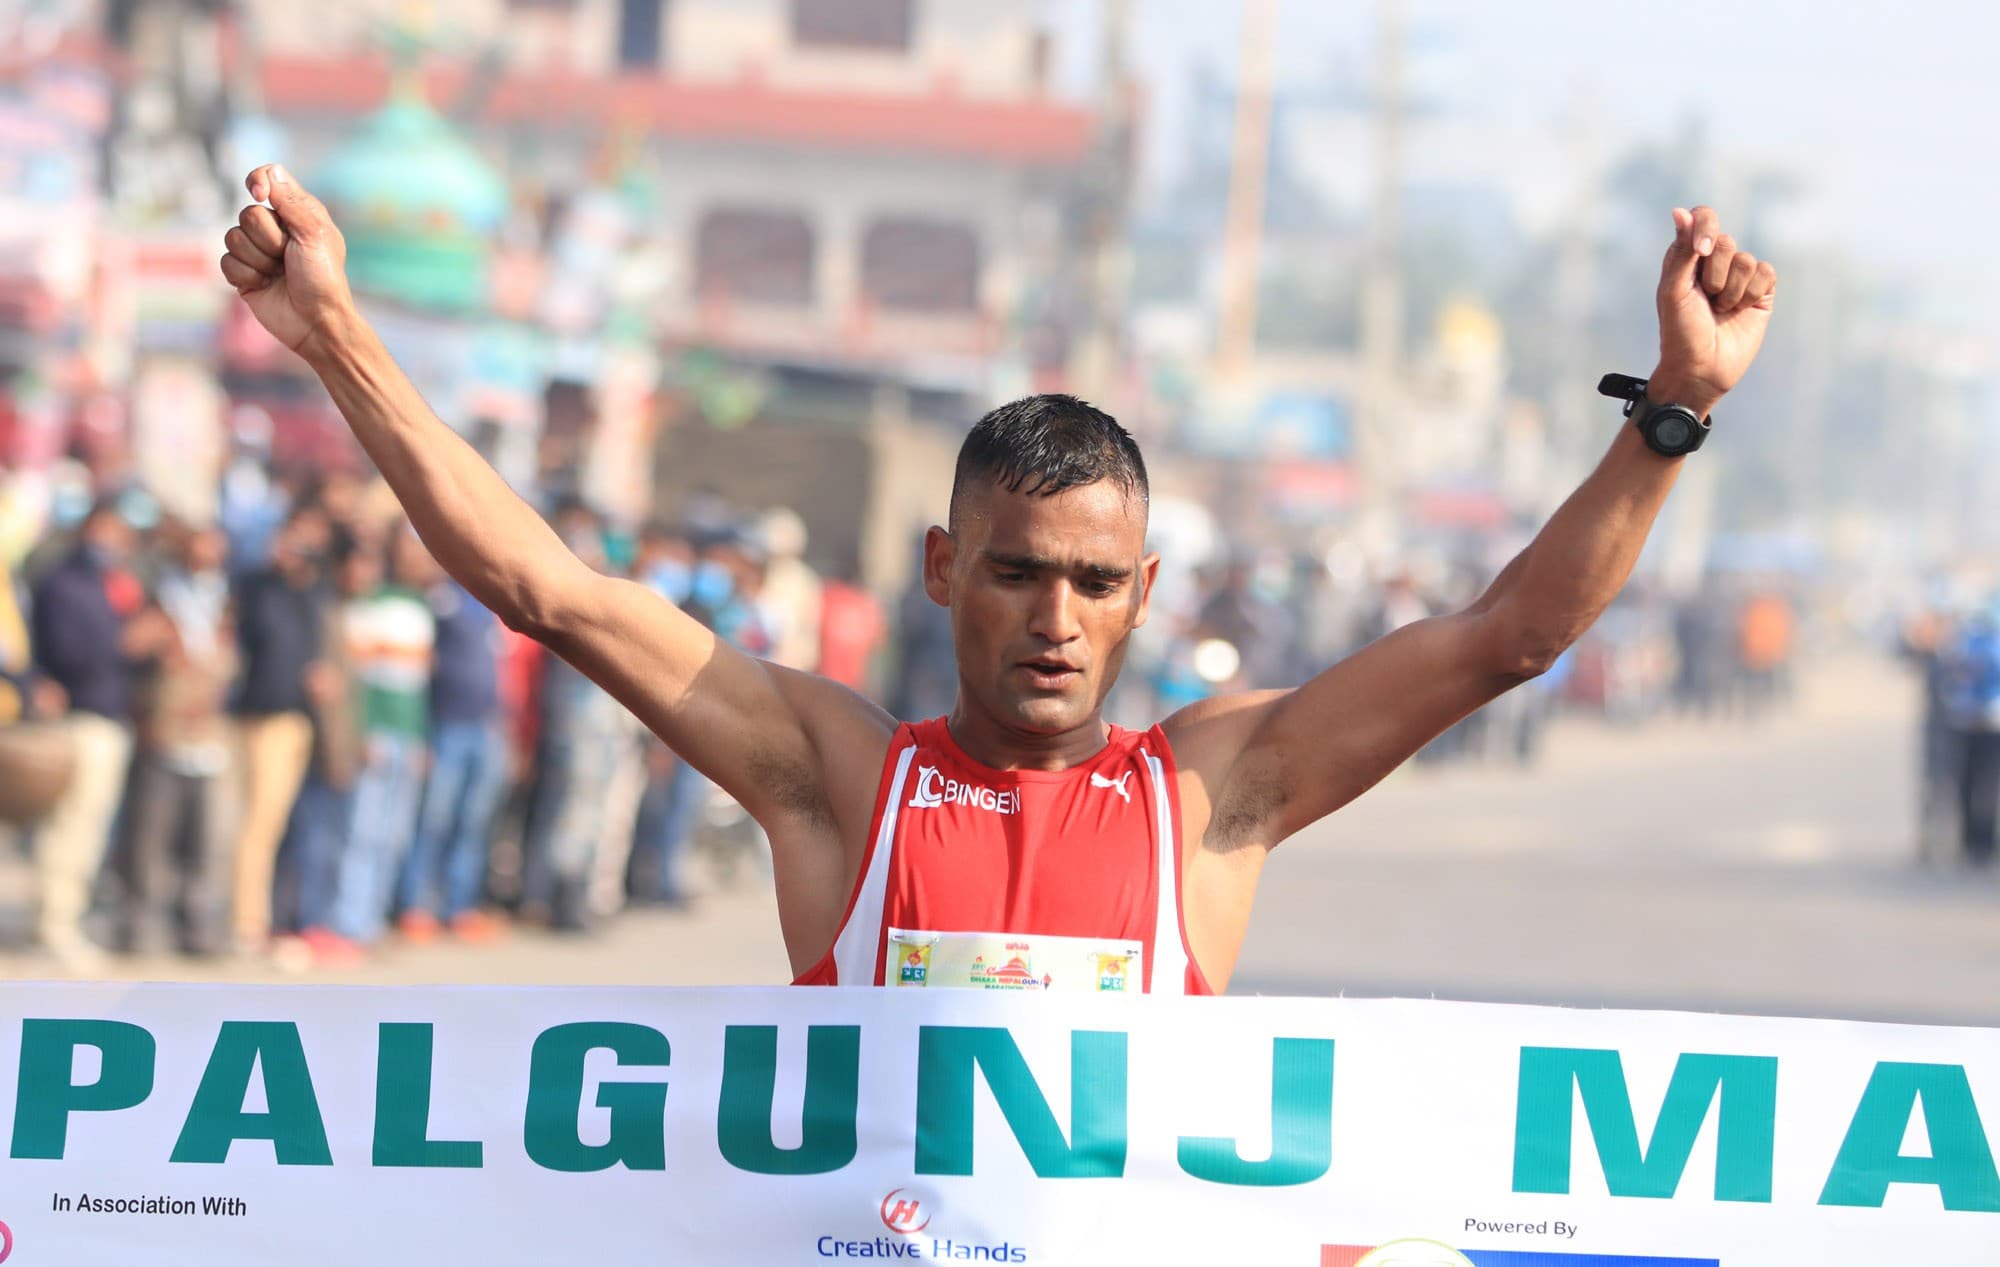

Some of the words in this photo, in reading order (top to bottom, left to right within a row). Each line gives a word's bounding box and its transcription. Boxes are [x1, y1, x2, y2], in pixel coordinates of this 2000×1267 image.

[944, 780, 1020, 814] BINGEN
[53, 1193, 71, 1212] In
[77, 1193, 196, 1215] Association
[202, 1197, 247, 1216] With
[1464, 1218, 1548, 1235] Powered
[1554, 1221, 1578, 1239] By
[817, 1236, 921, 1259] Creative
[933, 1239, 1027, 1263] Hands
